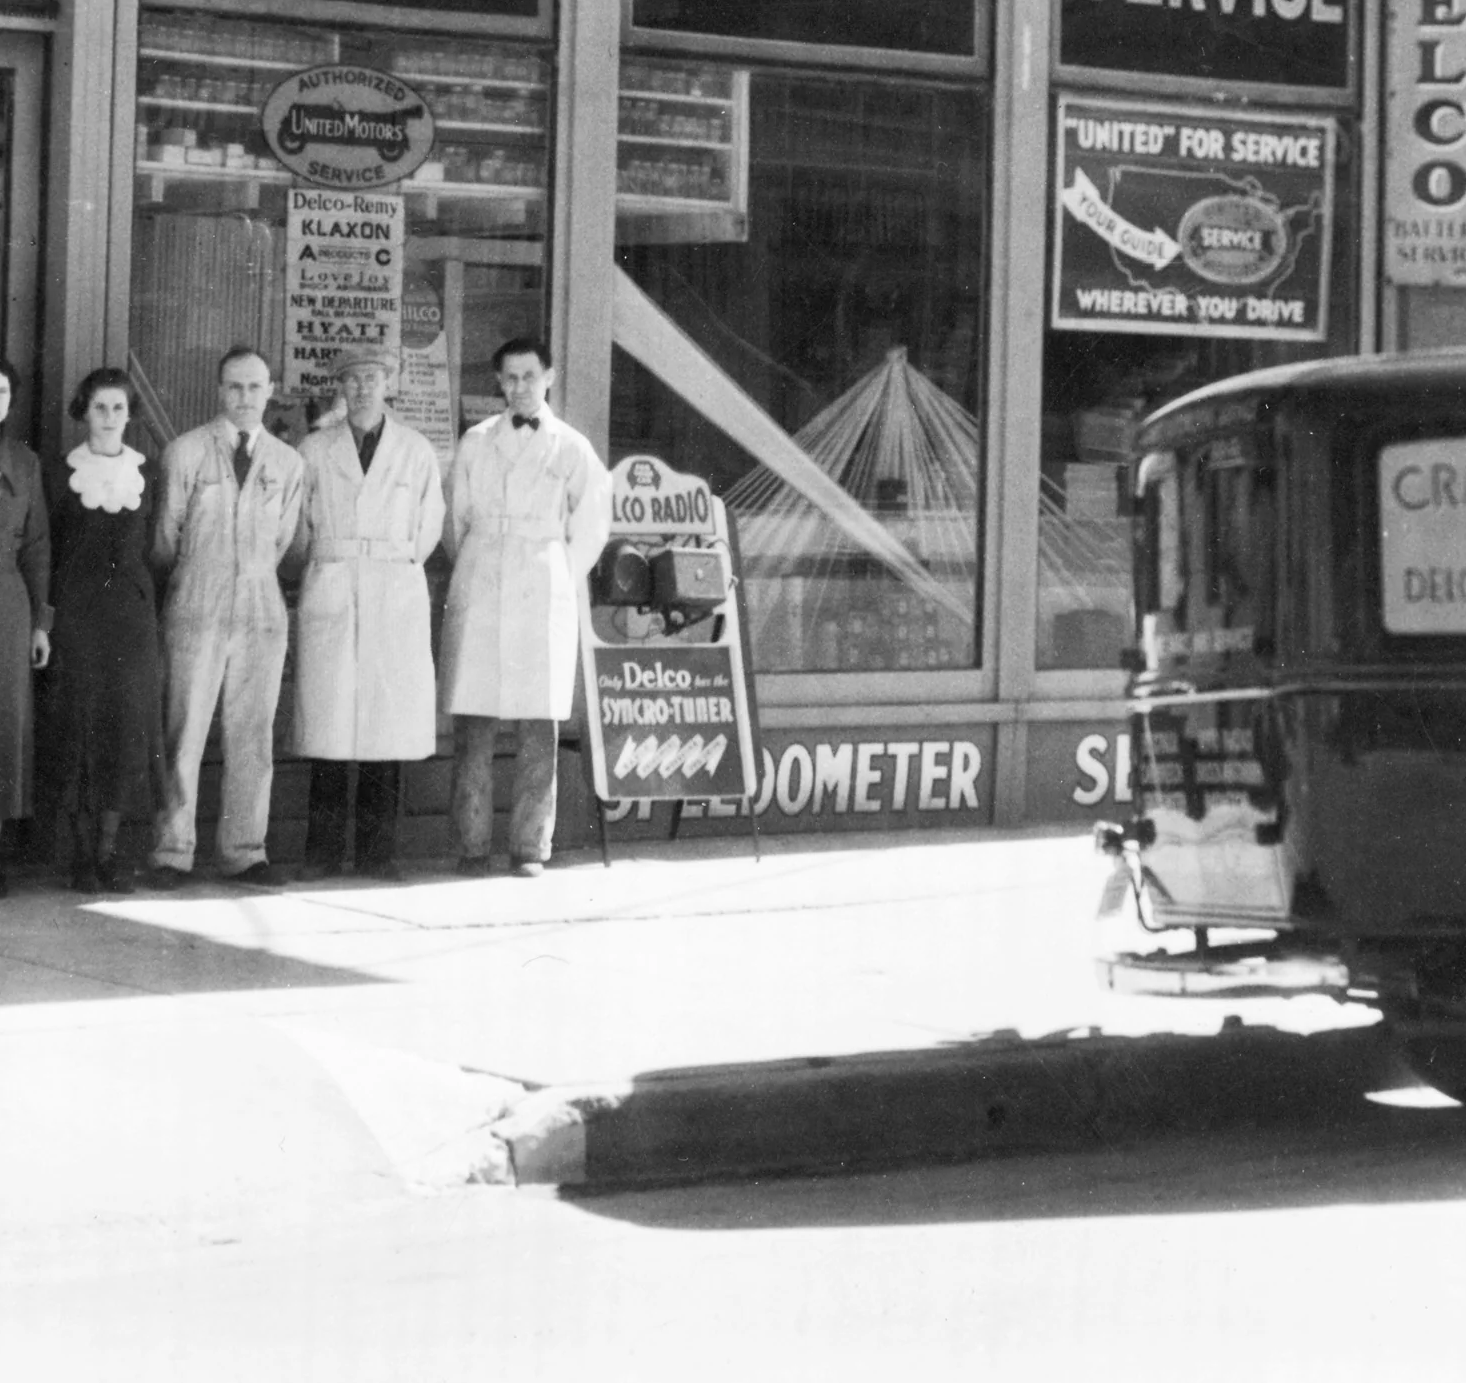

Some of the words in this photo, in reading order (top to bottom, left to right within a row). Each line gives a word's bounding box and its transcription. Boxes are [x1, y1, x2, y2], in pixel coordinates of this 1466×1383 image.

[298, 71, 406, 101] AUTHORIZED
[291, 109, 343, 138] UNITED
[344, 113, 404, 141] MOTORS
[1064, 118, 1176, 154] "UNITED"
[1179, 127, 1225, 159] FOR
[1231, 131, 1321, 167] SERVICE
[308, 160, 385, 183] SERVICE
[293, 192, 397, 218] Delco-Remy
[301, 219, 390, 240] KLAXON
[1079, 195, 1118, 235] YOUR
[1120, 228, 1165, 260] GUIDE
[1200, 227, 1263, 250] SERVICE
[298, 244, 317, 261] A
[375, 248, 391, 266] C
[290, 294, 317, 308] NEW
[321, 297, 397, 312] DEPARTURE
[1076, 288, 1188, 317] WHEREVER
[1196, 294, 1238, 320] YOU
[1246, 296, 1305, 323] DRIVE
[296, 321, 390, 337] HYATT
[651, 487, 709, 524] RADIO
[599, 674, 623, 692] Only
[623, 661, 693, 689] Delco
